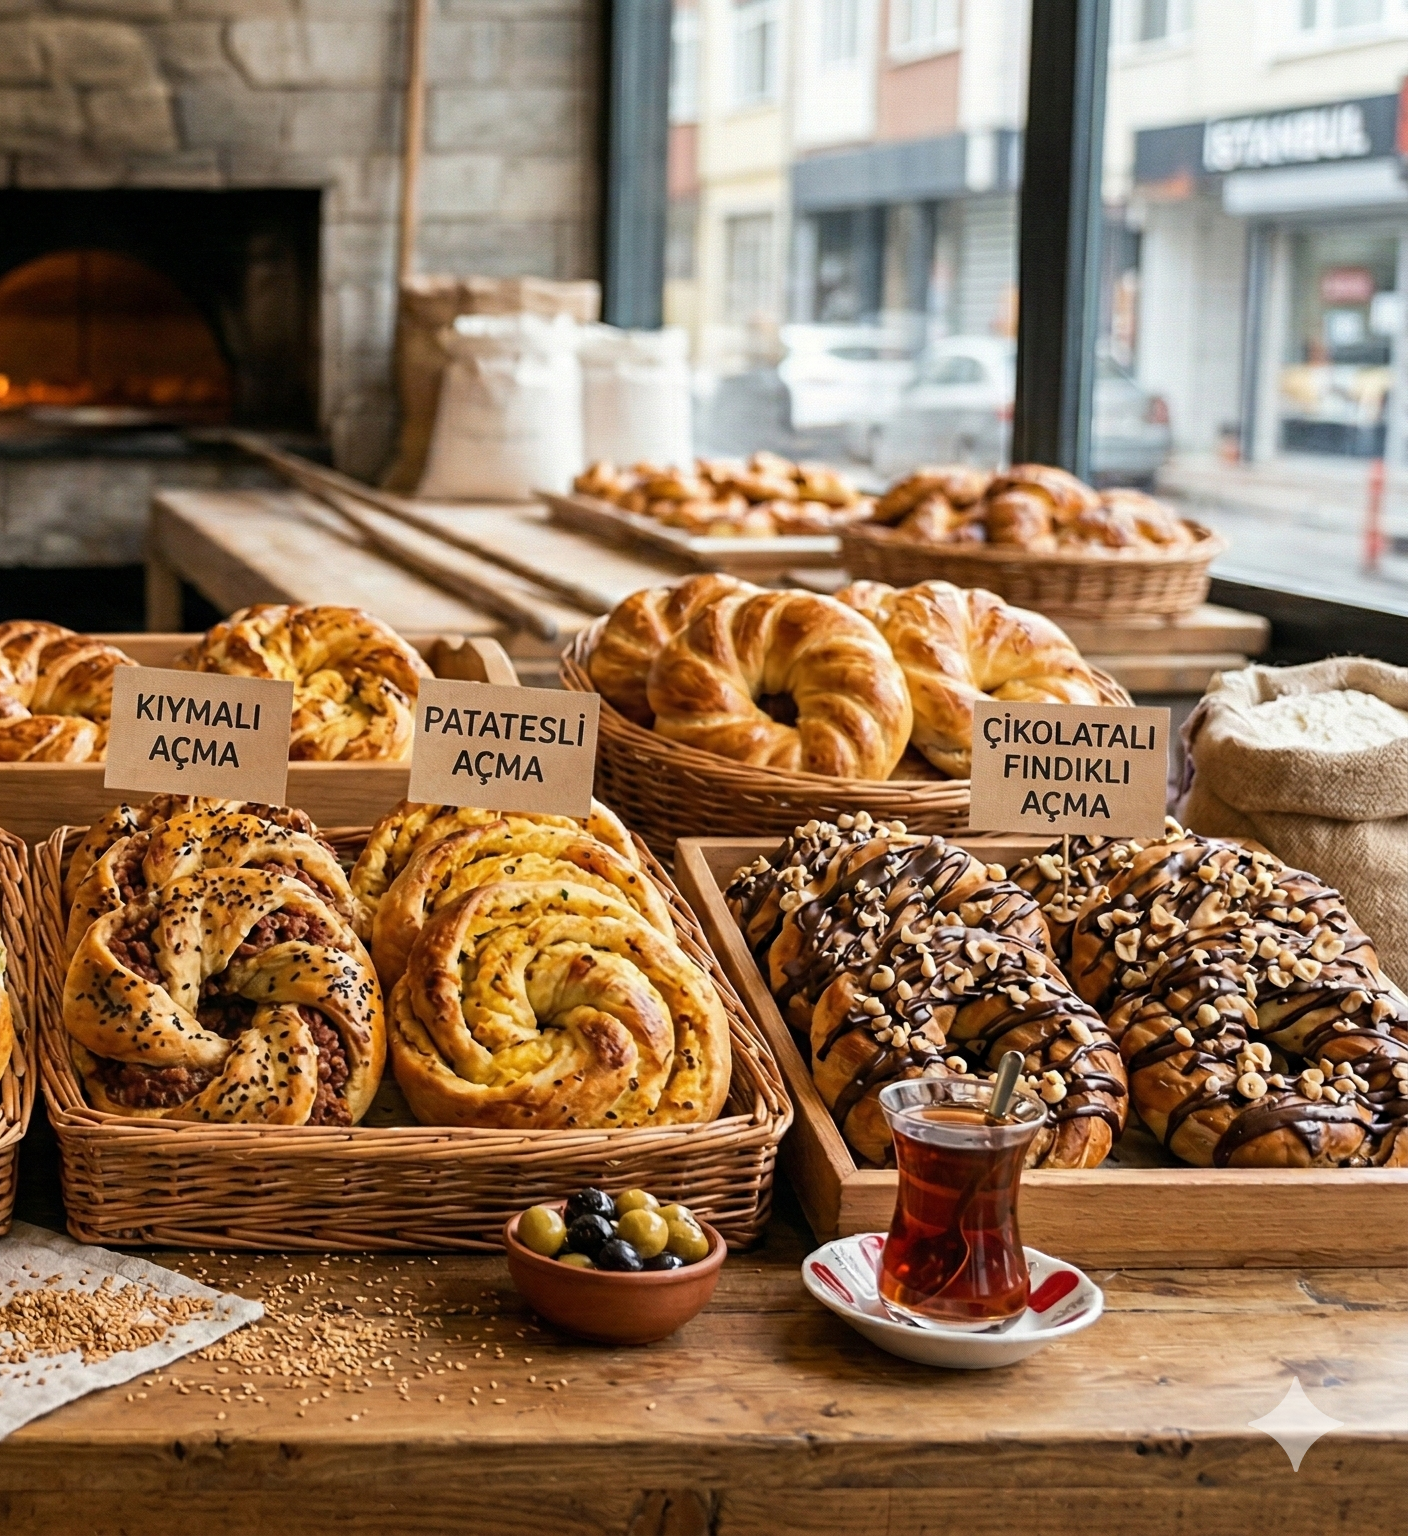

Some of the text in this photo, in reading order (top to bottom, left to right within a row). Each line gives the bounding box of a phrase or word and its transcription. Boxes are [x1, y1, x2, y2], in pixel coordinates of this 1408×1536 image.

[136, 693, 261, 731] KIYMALI
[424, 706, 587, 747] PATATESLİ
[982, 712, 1156, 751] ÇİKOLATALI
[148, 735, 241, 771] AÇMA
[451, 749, 545, 786] AÇMA
[1003, 753, 1131, 785] FINDIKLI
[1019, 790, 1112, 823] AÇMA
